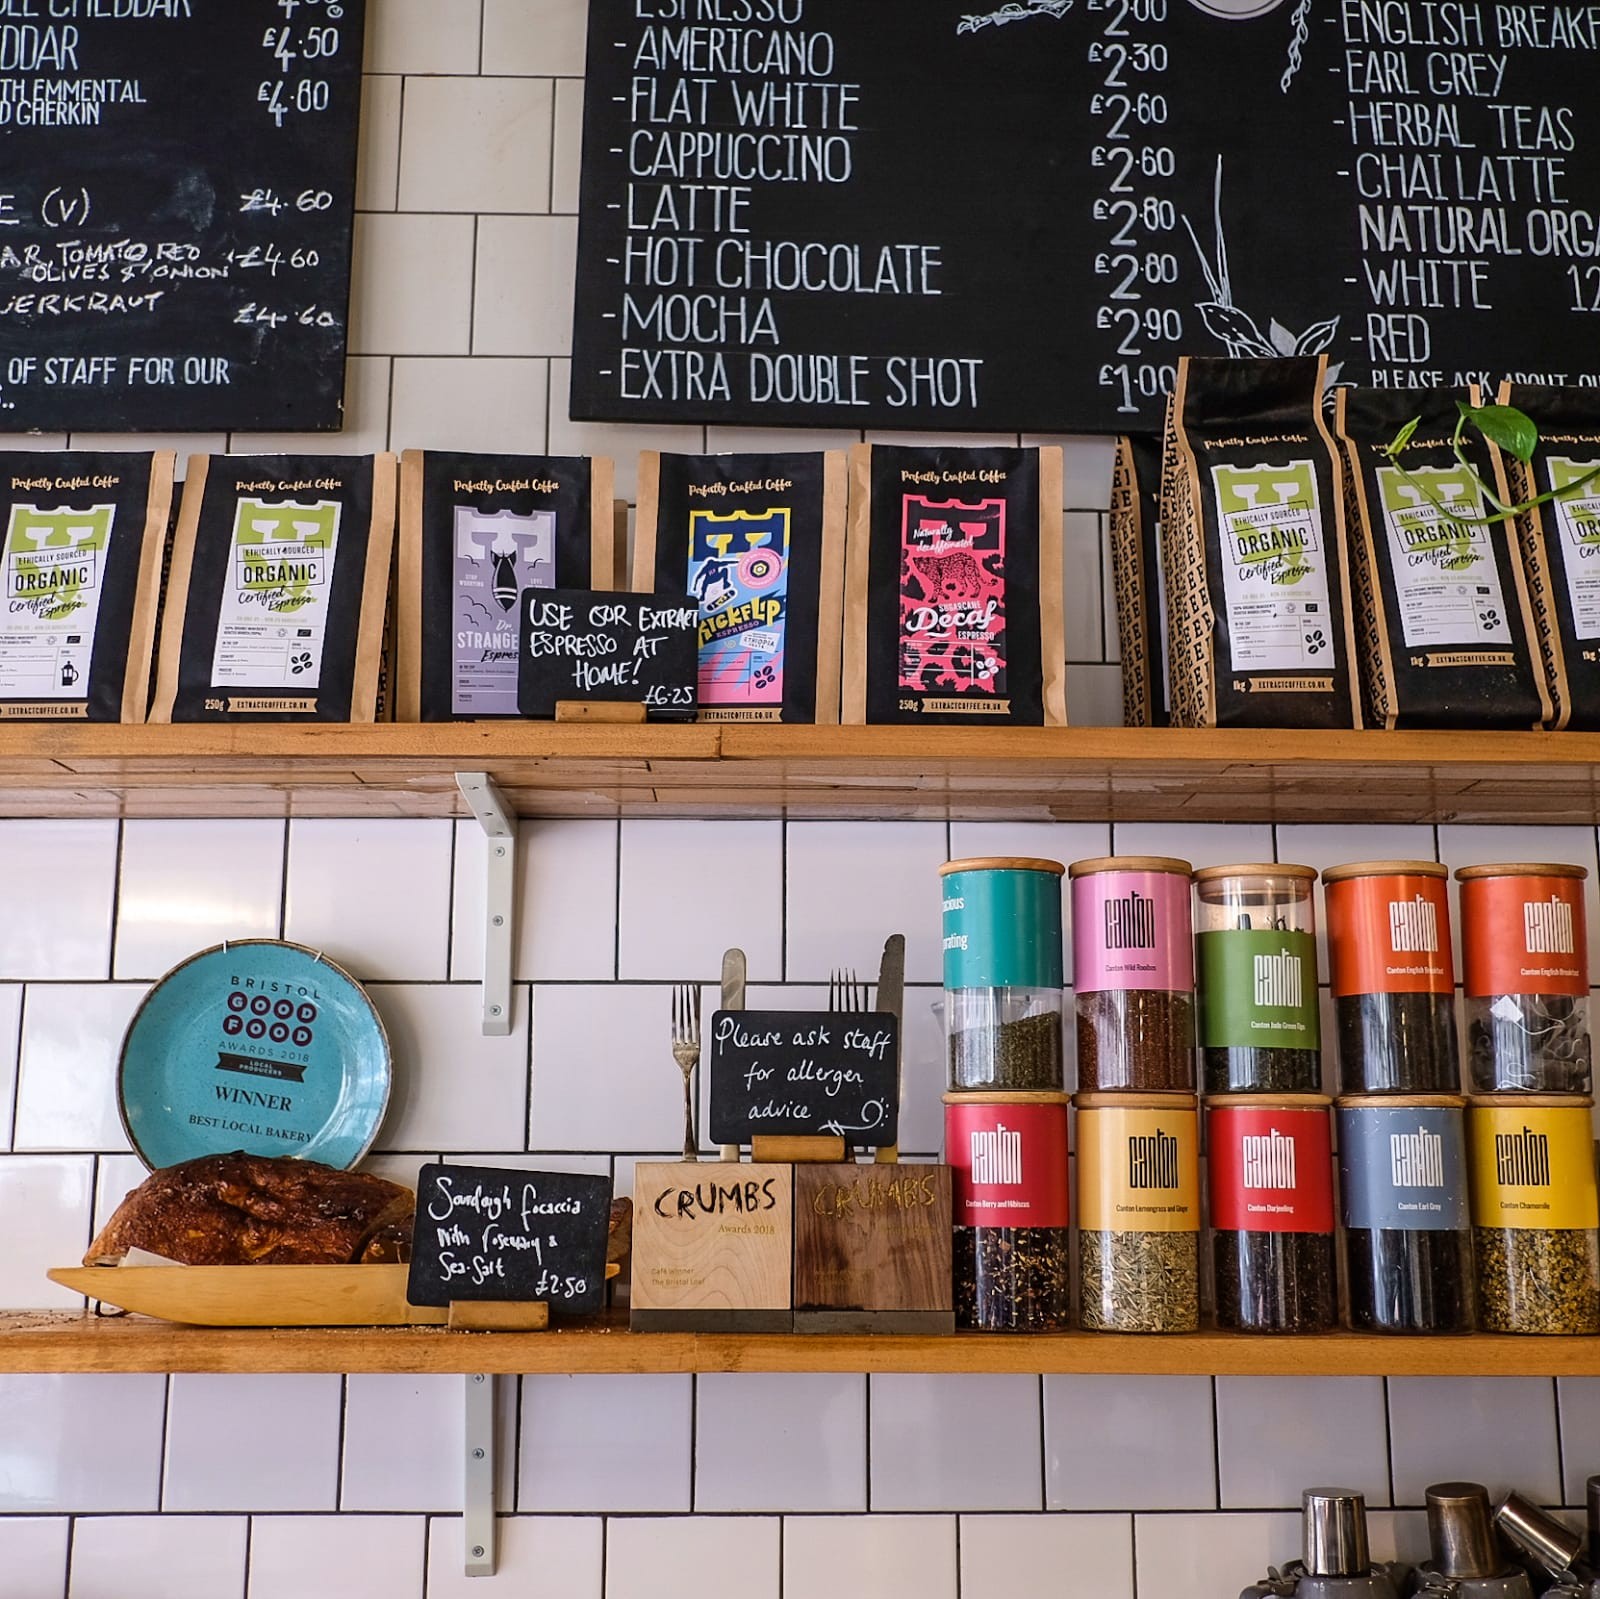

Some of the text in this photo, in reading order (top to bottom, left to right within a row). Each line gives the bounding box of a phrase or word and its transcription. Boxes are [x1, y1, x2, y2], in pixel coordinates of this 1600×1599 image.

[1341, 0, 1484, 47] ENGLISH
[262, 26, 339, 72] £4.50
[633, 26, 834, 76] AMERICANO
[1088, 42, 1169, 87] £2.30
[33, 79, 147, 103] EMMENTAL
[1346, 49, 1507, 97] EARL GREY
[17, 101, 100, 125] GHERKIN
[631, 77, 860, 130] FLAT WHITE
[1090, 93, 1168, 139] £2.60
[1349, 101, 1576, 151] HERBAL TEAS
[629, 130, 851, 182] CAPPUCCINO
[1091, 146, 1176, 193] £2.60
[1356, 153, 1569, 204] CHAI LATTE
[628, 183, 752, 233] LATTE
[1093, 197, 1176, 247] £2.80
[1358, 204, 1523, 255] NATURAL
[32, 261, 110, 283] OLIVES
[153, 264, 229, 280] ONION
[156, 243, 201, 260] RED
[625, 236, 942, 295] HOT CHOCOLATE
[1095, 252, 1178, 300] £2.80
[1363, 258, 1492, 310] WHITE
[622, 293, 780, 345] MOCHA
[1097, 306, 1183, 356] £2.90
[1367, 313, 1431, 363] RED
[8, 356, 231, 385] OF STAFF FOR OUR
[620, 348, 984, 408] EXTRA DOUBLE SHOT
[1237, 527, 1309, 556] ORGANIC
[1404, 522, 1476, 546] ORGANIC
[15, 566, 88, 592] ORGANIC
[243, 563, 317, 584] ORGANIC
[1239, 553, 1284, 581] Certified
[9, 591, 56, 614] Certified
[39, 601, 82, 619] Espresso
[238, 585, 285, 607] Certified
[268, 595, 312, 612] Espresso
[529, 599, 699, 631] USE OUR EXTRACT
[906, 599, 997, 632] Decaf
[457, 630, 519, 650] STRANGE
[496, 619, 514, 632] Dr.
[530, 631, 670, 659] ESPRESSO AT
[958, 631, 995, 641] ESPRESSO
[571, 657, 643, 691] HOME!
[1105, 890, 1156, 949] canton
[1389, 893, 1439, 952] canton
[1523, 894, 1574, 954] canton
[231, 975, 321, 1000] BRISTOL
[1253, 947, 1303, 1008] canton
[229, 993, 316, 1022] GOOD
[219, 1040, 310, 1063] AWARDS 2018
[225, 1016, 311, 1045] FOOD
[715, 1016, 891, 1060] Please ask staff
[215, 1085, 293, 1112] WINNER
[743, 1058, 864, 1097] for allergen
[189, 1113, 313, 1143] BEST LOCAL BAKERY
[748, 1100, 812, 1119] advice
[971, 1122, 1022, 1185] canton
[1129, 1127, 1179, 1189] canton
[1242, 1126, 1296, 1189] canton
[1390, 1125, 1444, 1187] canton
[1495, 1125, 1550, 1186] canton
[520, 1183, 581, 1233] focaccia
[654, 1177, 776, 1221] CRUMBS
[813, 1174, 937, 1220] CRUMBS
[718, 1223, 776, 1236] Awards 2018
